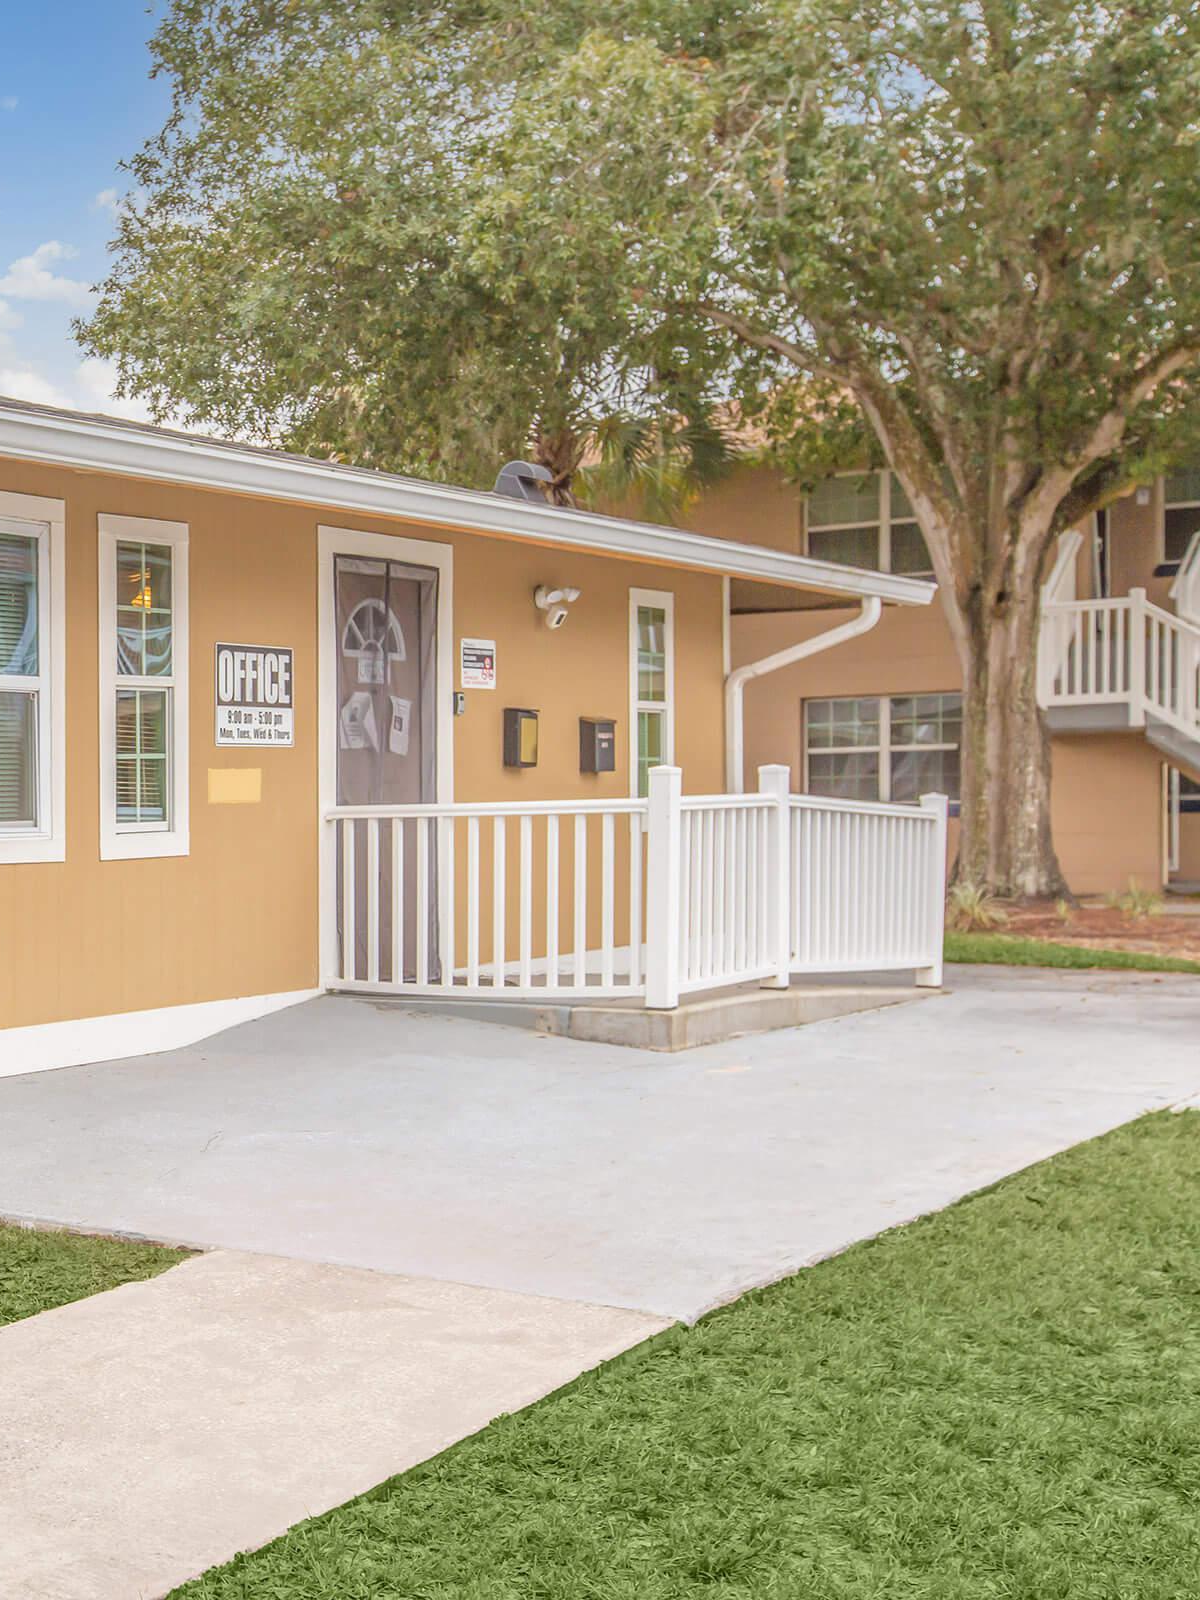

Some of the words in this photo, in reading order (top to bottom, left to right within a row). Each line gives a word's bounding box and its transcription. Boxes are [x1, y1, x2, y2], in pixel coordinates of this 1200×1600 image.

[219, 649, 290, 704] OFFICE
[243, 713, 253, 724] am
[258, 711, 272, 725] 5:00
[274, 714, 283, 726] pm
[219, 727, 235, 739] Mon,
[237, 727, 252, 739] Tues,
[254, 728, 266, 739] Wed
[268, 728, 272, 739] &
[274, 728, 290, 740] Thurs
